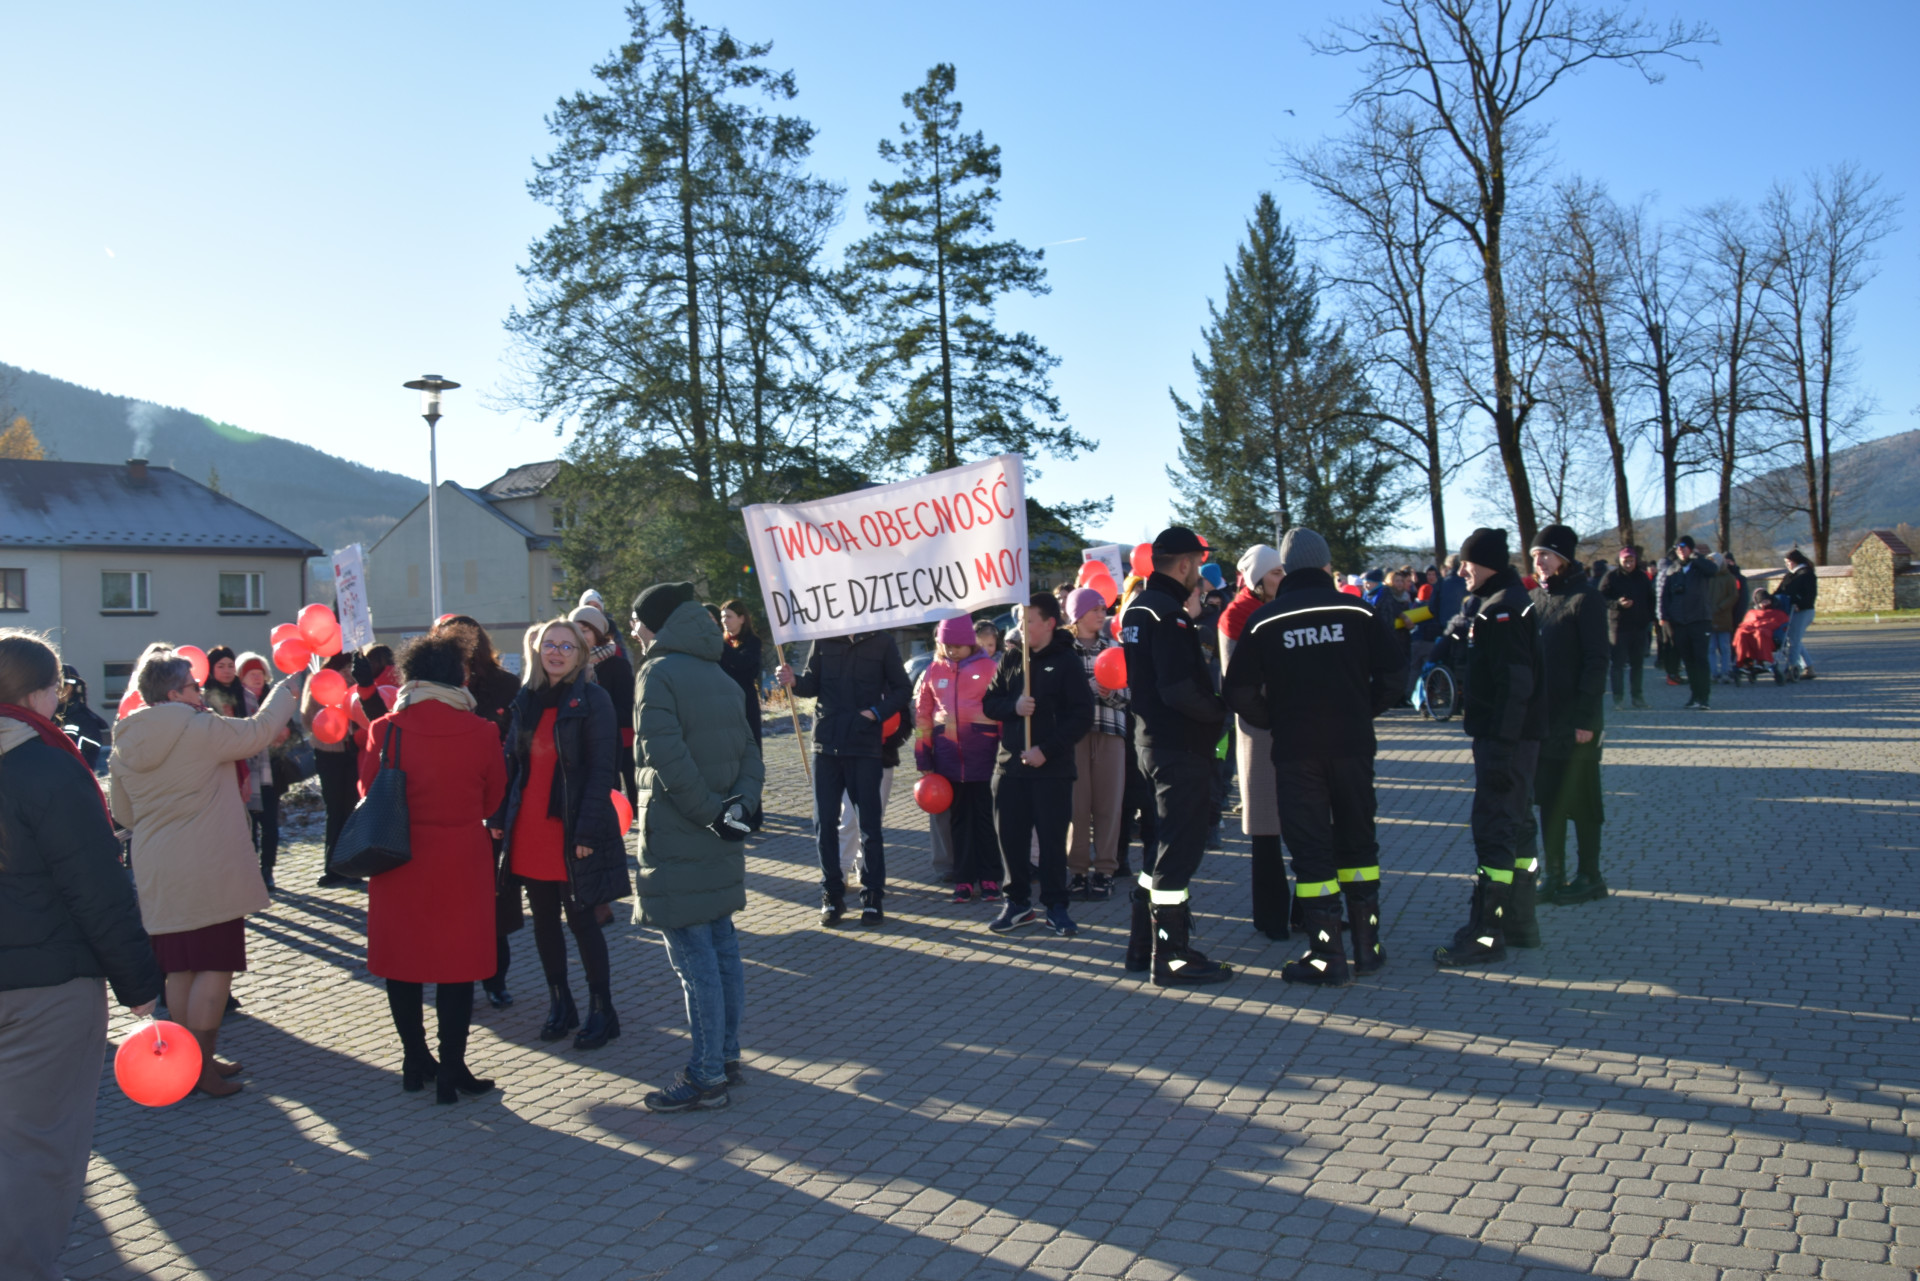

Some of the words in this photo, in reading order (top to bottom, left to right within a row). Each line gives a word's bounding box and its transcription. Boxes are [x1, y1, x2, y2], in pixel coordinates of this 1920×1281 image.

[764, 519, 863, 563] TWOJA
[860, 472, 1015, 548] OBECNOŚĆ
[771, 583, 845, 627] DAJE
[847, 560, 969, 617] DZIECKU
